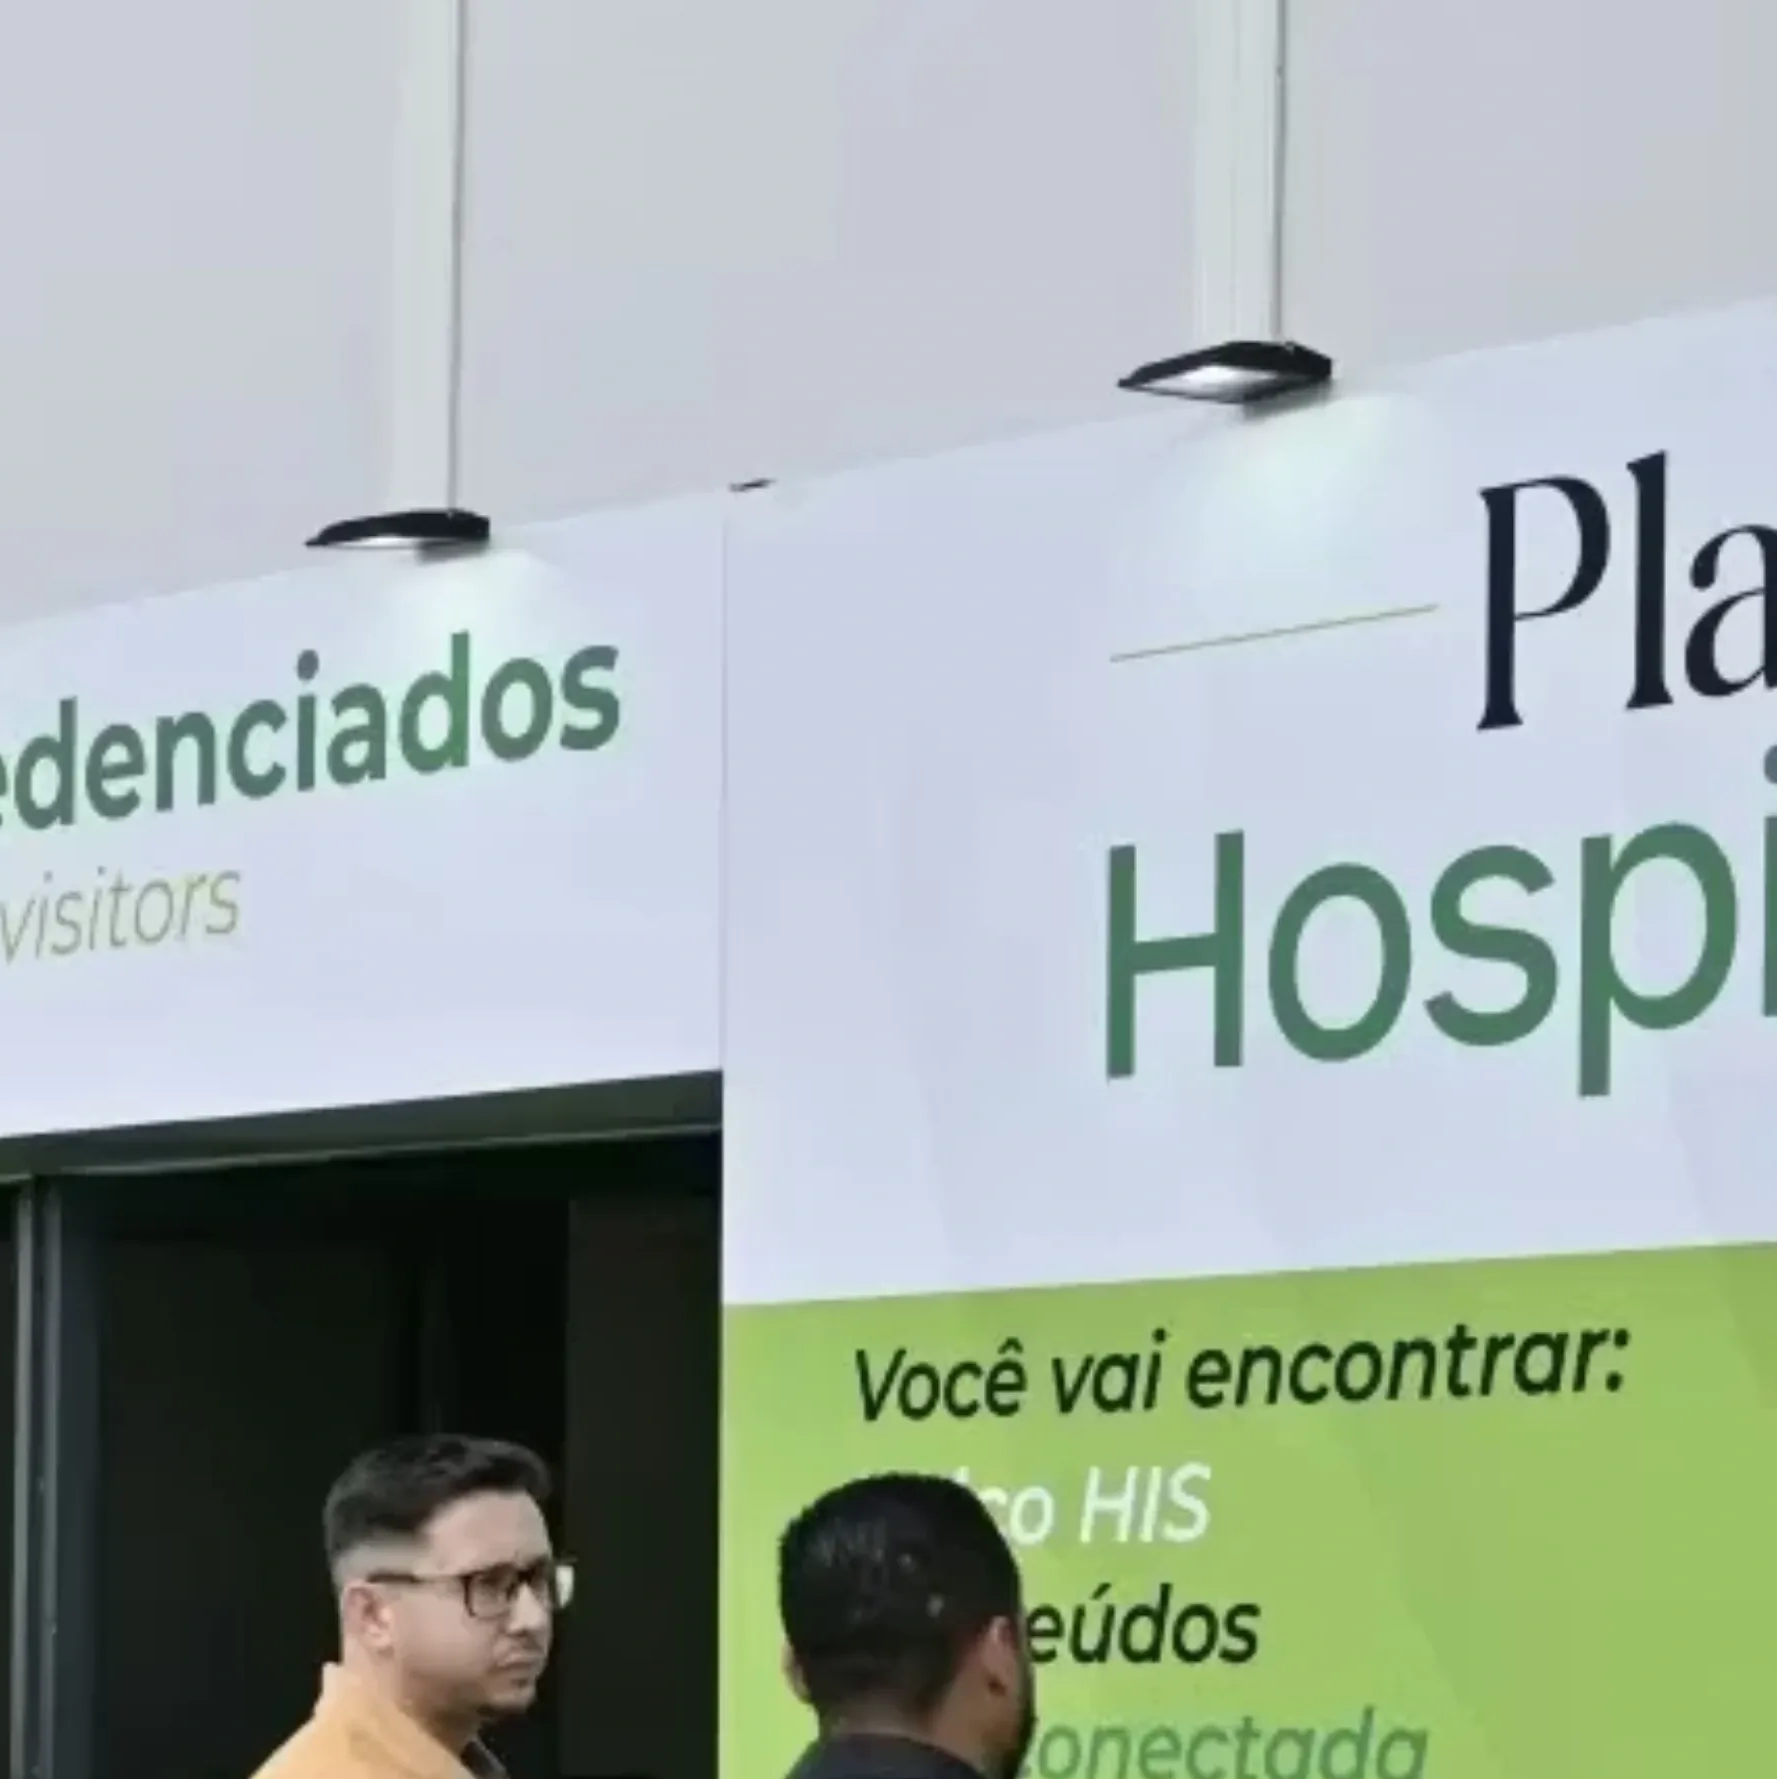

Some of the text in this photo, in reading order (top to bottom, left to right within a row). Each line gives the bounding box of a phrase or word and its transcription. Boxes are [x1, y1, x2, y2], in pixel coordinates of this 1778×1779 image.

[855, 1324, 1630, 1421] Você vai encontrar:
[1078, 1462, 1212, 1543] HIS
[1026, 1583, 1261, 1664] eúdos
